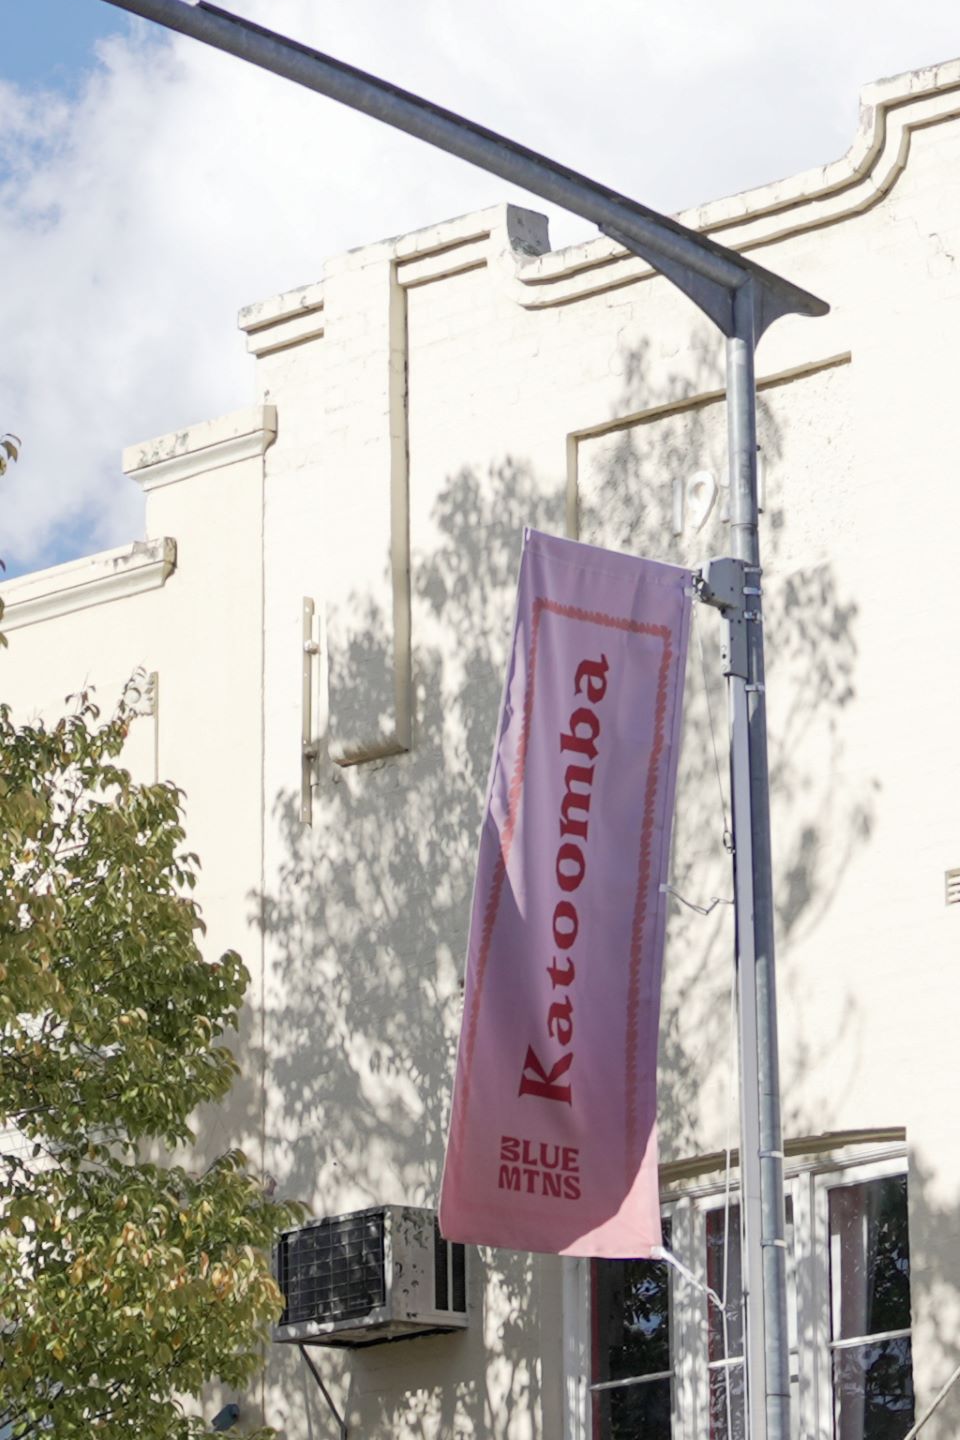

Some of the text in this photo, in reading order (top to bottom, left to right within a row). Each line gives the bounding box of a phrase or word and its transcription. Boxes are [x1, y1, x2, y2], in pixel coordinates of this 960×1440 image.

[518, 653, 609, 1107] Katoomba
[500, 1135, 580, 1173] BLUE
[498, 1163, 581, 1201] MTNS
